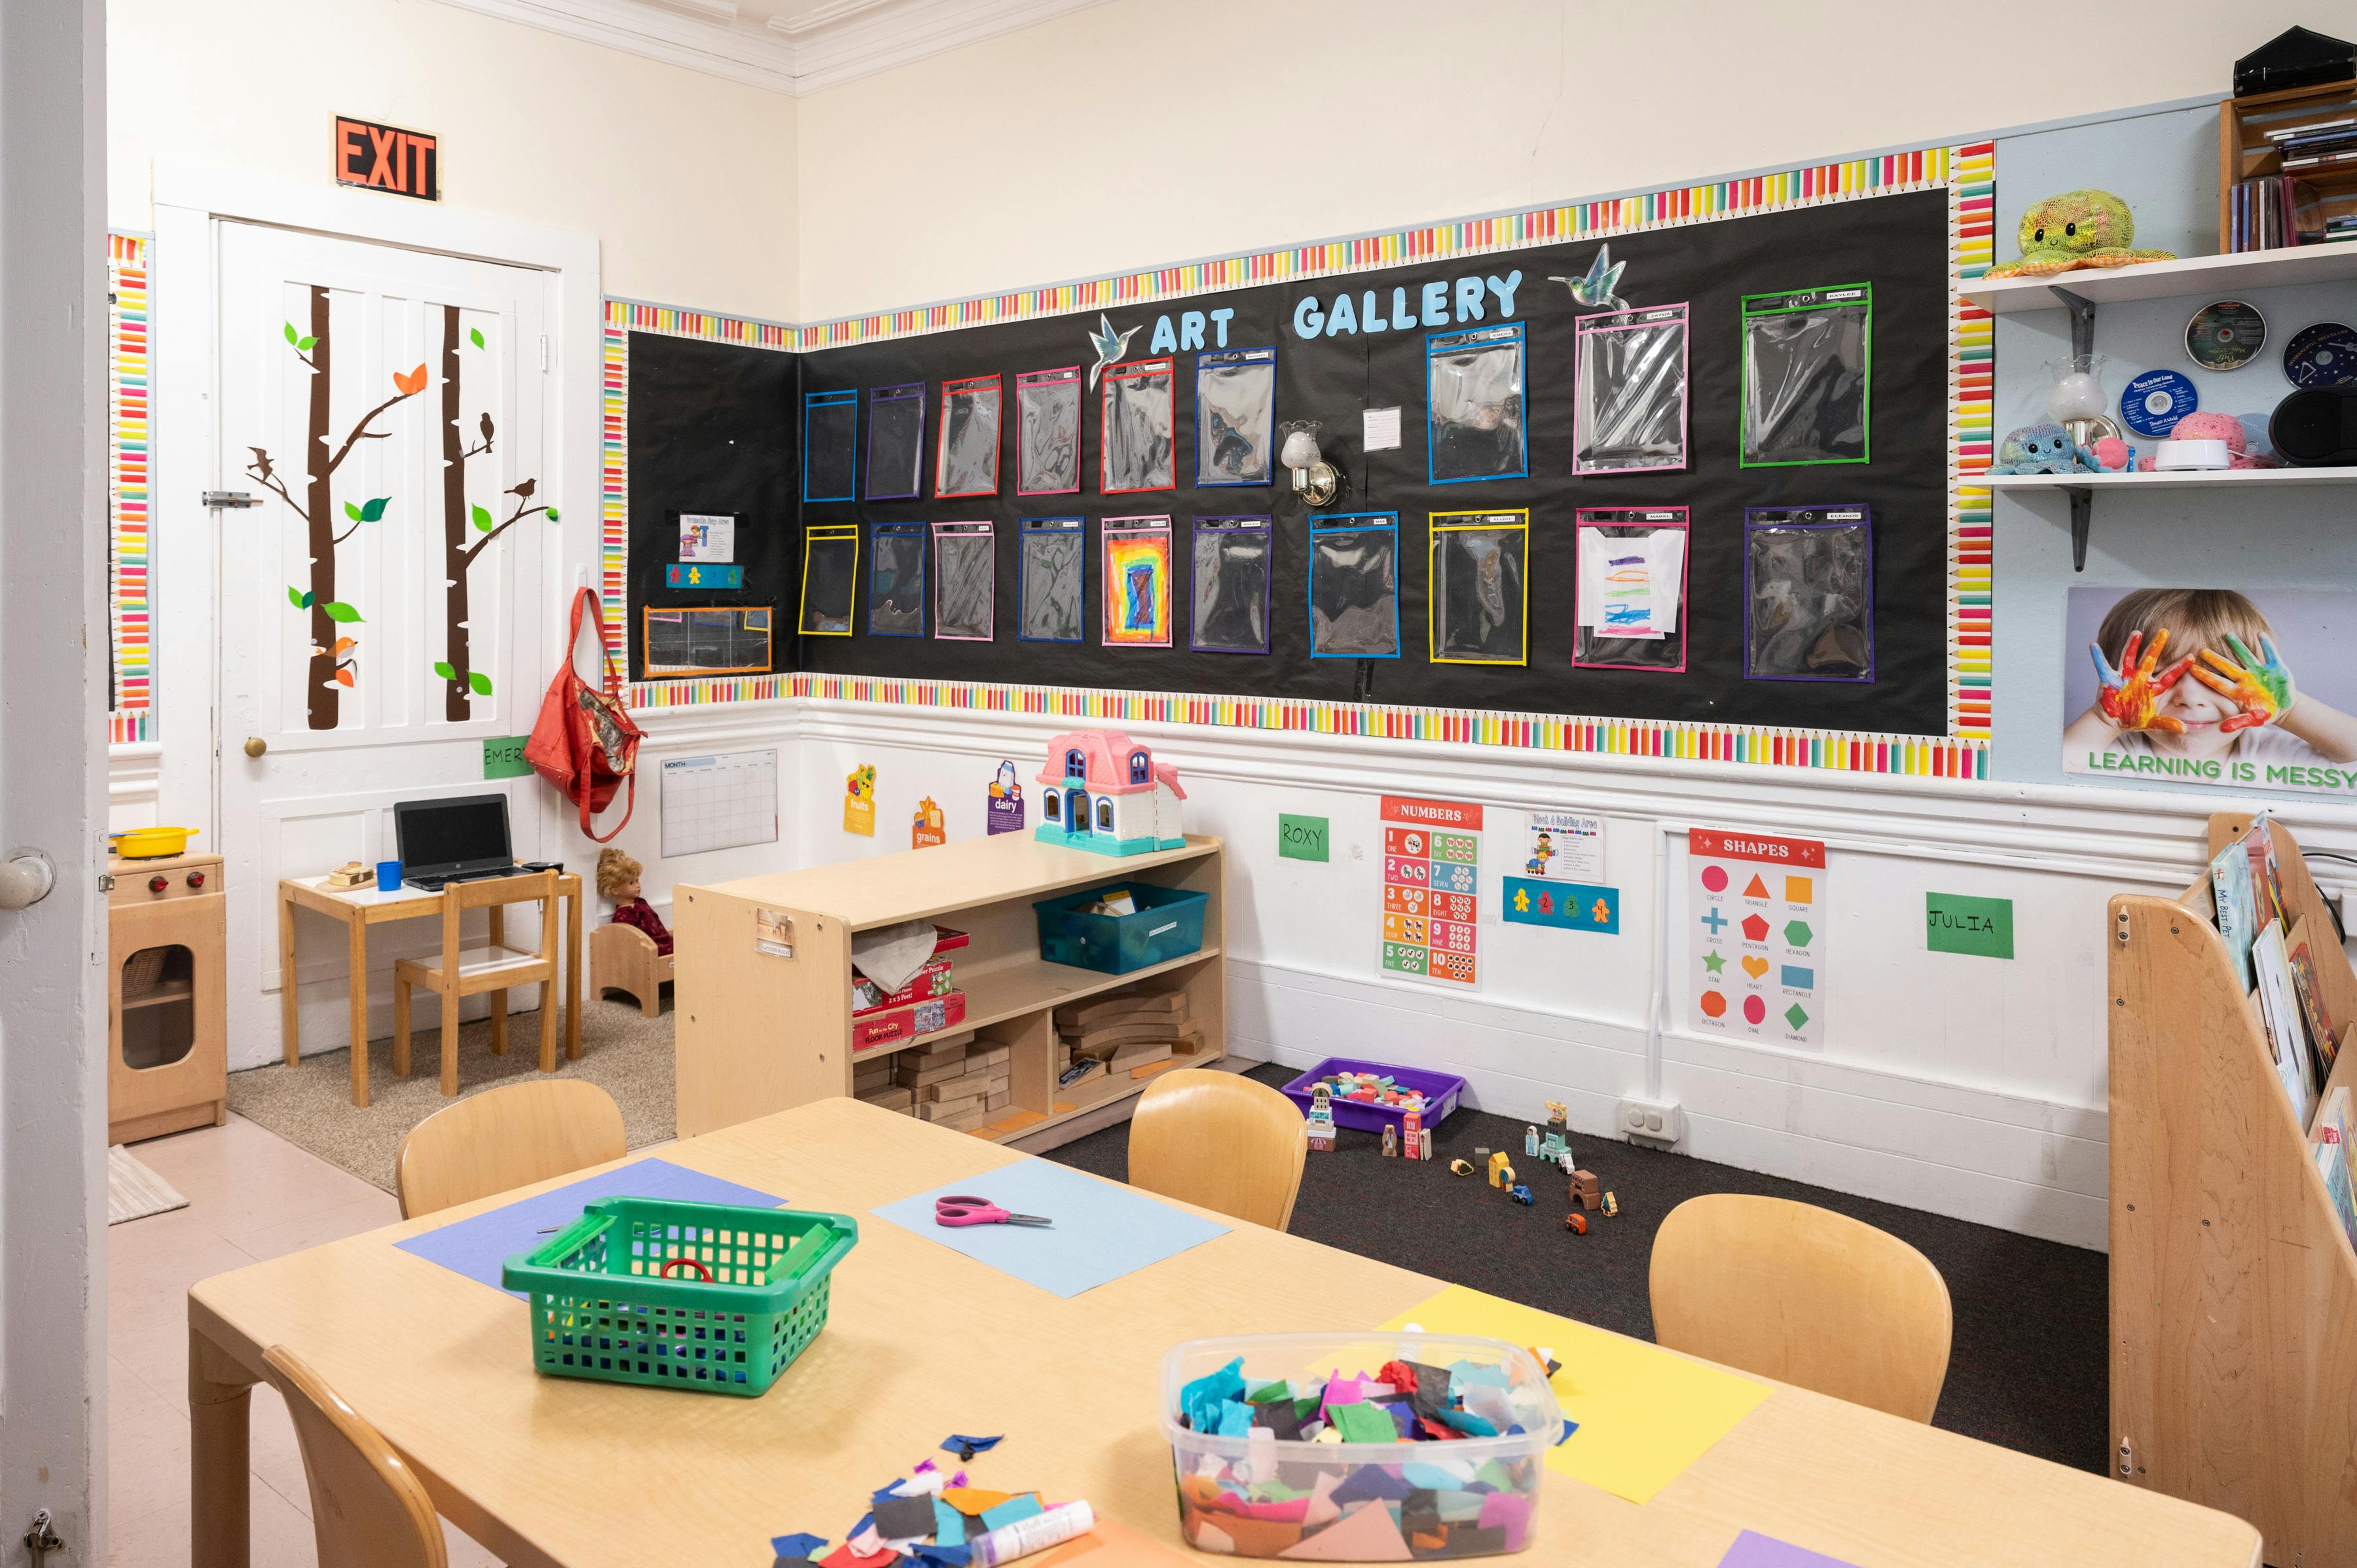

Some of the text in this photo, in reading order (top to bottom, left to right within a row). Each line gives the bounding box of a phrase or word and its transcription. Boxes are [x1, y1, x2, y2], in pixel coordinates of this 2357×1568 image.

[337, 120, 435, 196] EXIT
[1150, 269, 1523, 355] ART GALLERY
[2132, 380, 2148, 389] Peace
[484, 748, 525, 765] EMER
[2089, 752, 2357, 789] LEARNING IS MESSY
[850, 799, 869, 811] fruits
[995, 798, 1017, 813] dairy
[1401, 805, 1462, 821] NUMBERS
[1533, 813, 1549, 825] Block
[1556, 815, 1580, 830] Building
[1581, 818, 1598, 829] Area
[917, 833, 940, 843] grains
[1284, 824, 1322, 851] ROXY
[1387, 830, 1393, 842] 1
[1434, 835, 1442, 847] 6
[1723, 839, 1789, 858] SHAPES
[1387, 859, 1395, 871] 2
[1434, 865, 1441, 876] 7
[1387, 888, 1395, 900] 3
[1433, 894, 1441, 906] 8
[1387, 902, 1402, 911] THREE
[1543, 898, 1548, 908] 2
[1569, 901, 1574, 910] 3
[1598, 905, 1603, 915] 4
[1744, 899, 1768, 907] TRIANGLE
[2218, 890, 2232, 938] MY BEST PET
[1387, 917, 1395, 928] 4
[1929, 911, 1994, 934] JULIA
[1433, 923, 1441, 935] 9
[1386, 945, 1394, 957] 5
[1742, 942, 1768, 951] PENTAGON
[1785, 949, 1810, 957] HEXAGON
[1433, 953, 1446, 966] 10
[928, 965, 944, 974] Puzzle
[901, 992, 913, 1000] Feet!
[1782, 989, 1812, 998] RECTANGLE
[1702, 1019, 1725, 1028] OCTAGON
[865, 1029, 903, 1044] FLOOR PUZZLE
[1785, 1033, 1808, 1042] DIAMOND
